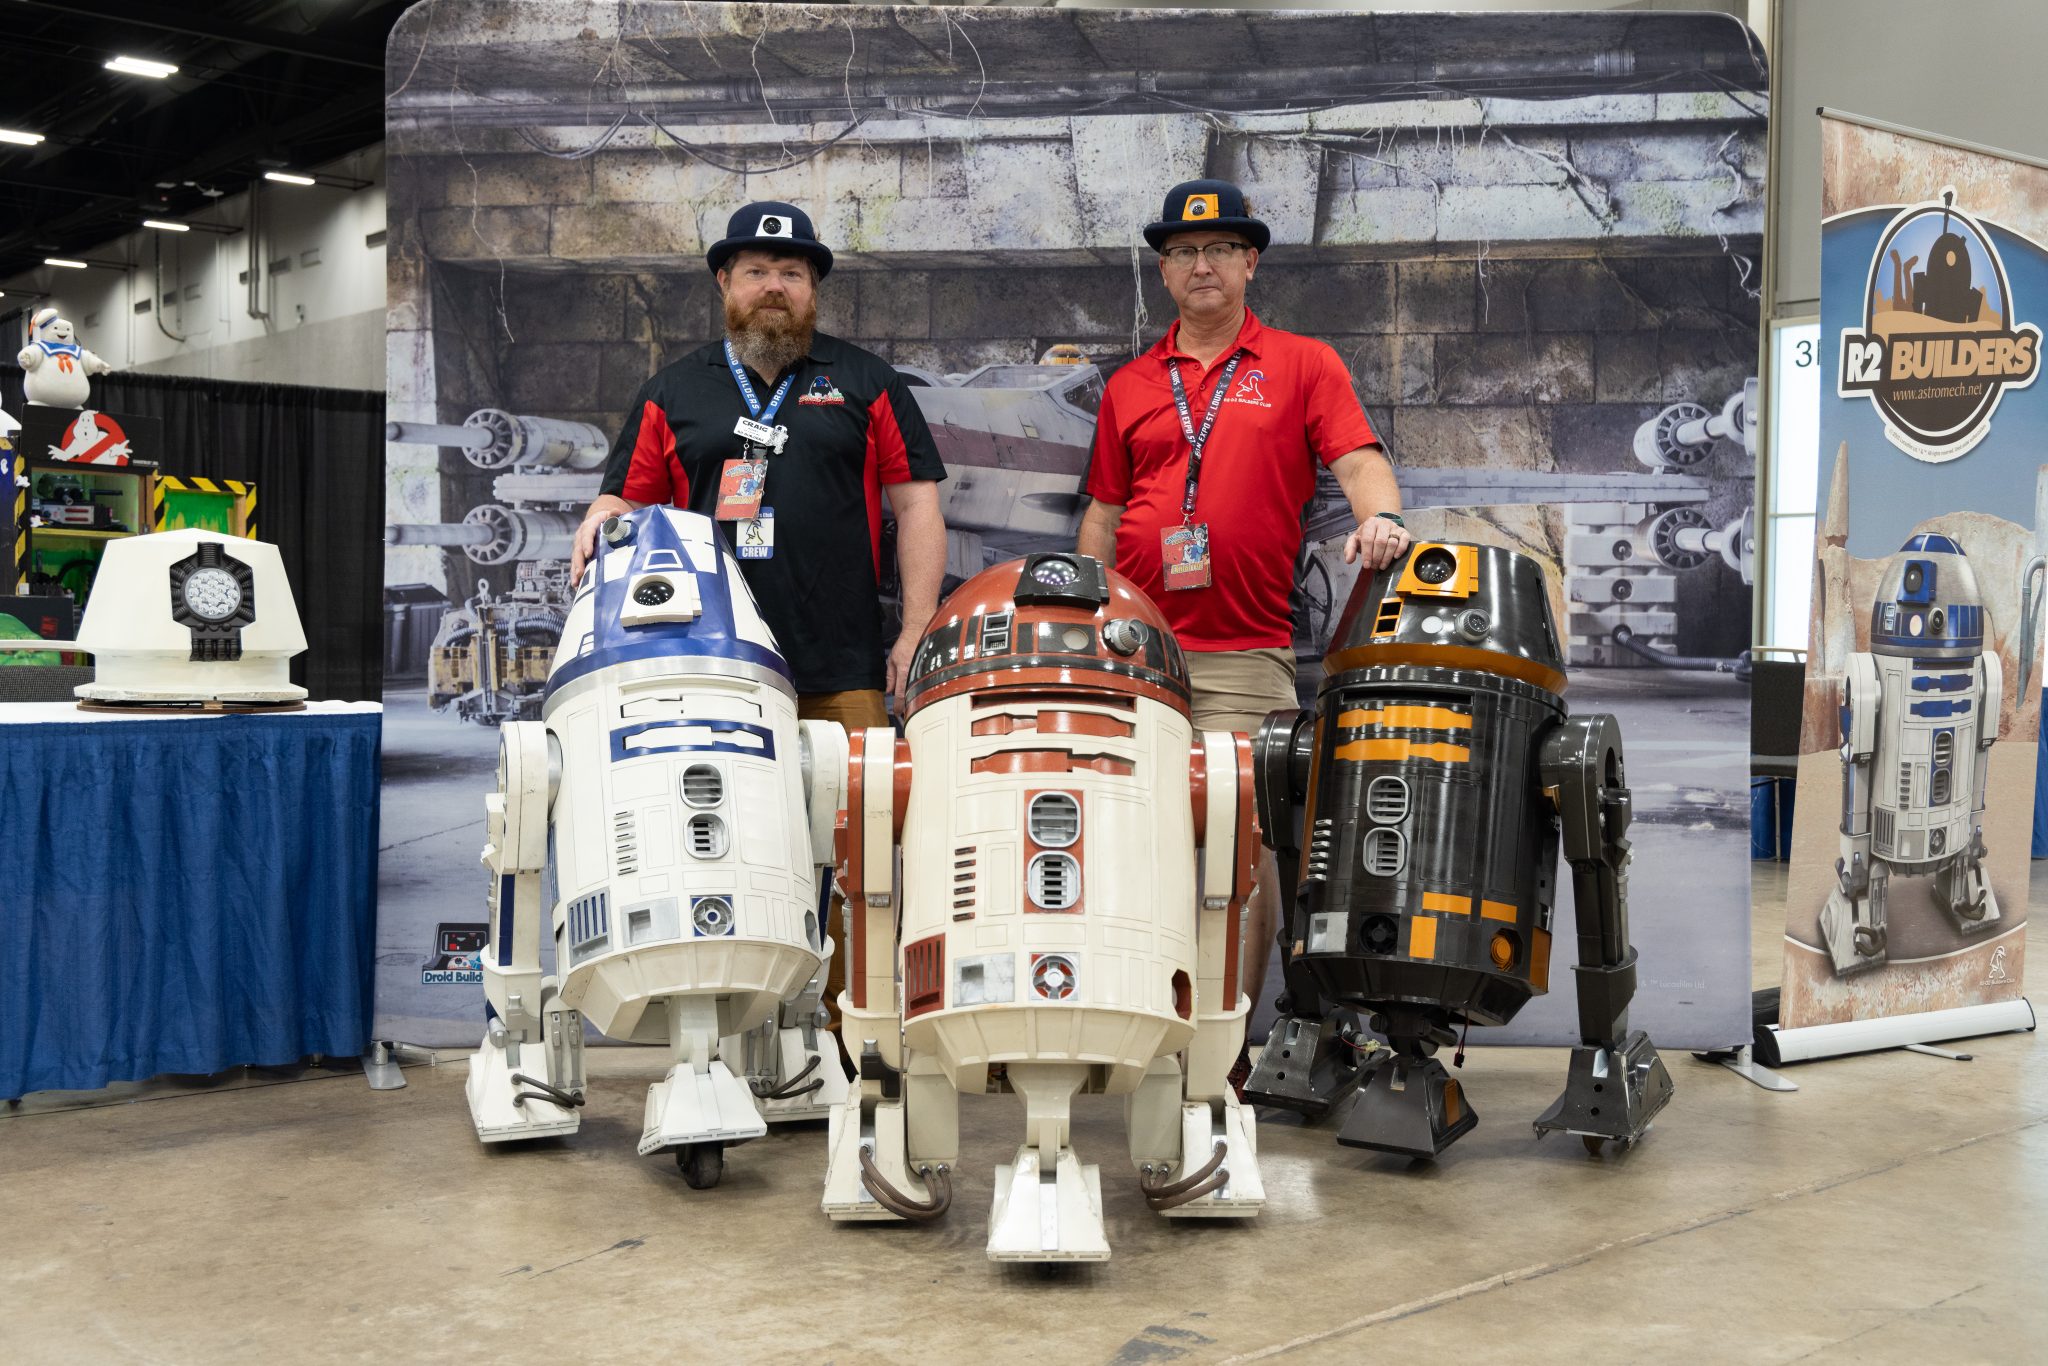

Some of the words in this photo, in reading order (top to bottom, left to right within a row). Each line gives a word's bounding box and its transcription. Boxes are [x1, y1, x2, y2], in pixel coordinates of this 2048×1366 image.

[1227, 359, 1238, 372] FAN
[1847, 341, 1882, 382] R2
[1891, 336, 2033, 380] BUILDERS
[726, 341, 739, 366] DROID
[735, 368, 760, 410] BUILDERS
[1170, 367, 1181, 386] LOUIS
[1893, 382, 1983, 401] www.astromech.net
[1178, 401, 1189, 416] FAN
[1198, 422, 1211, 443] EXPO
[1210, 390, 1224, 411] LOUIS
[742, 420, 768, 433] CRAIG
[1182, 416, 1194, 435] EXPO
[742, 546, 768, 558] CREW
[424, 971, 453, 982] Droid
[455, 971, 483, 982] Build
